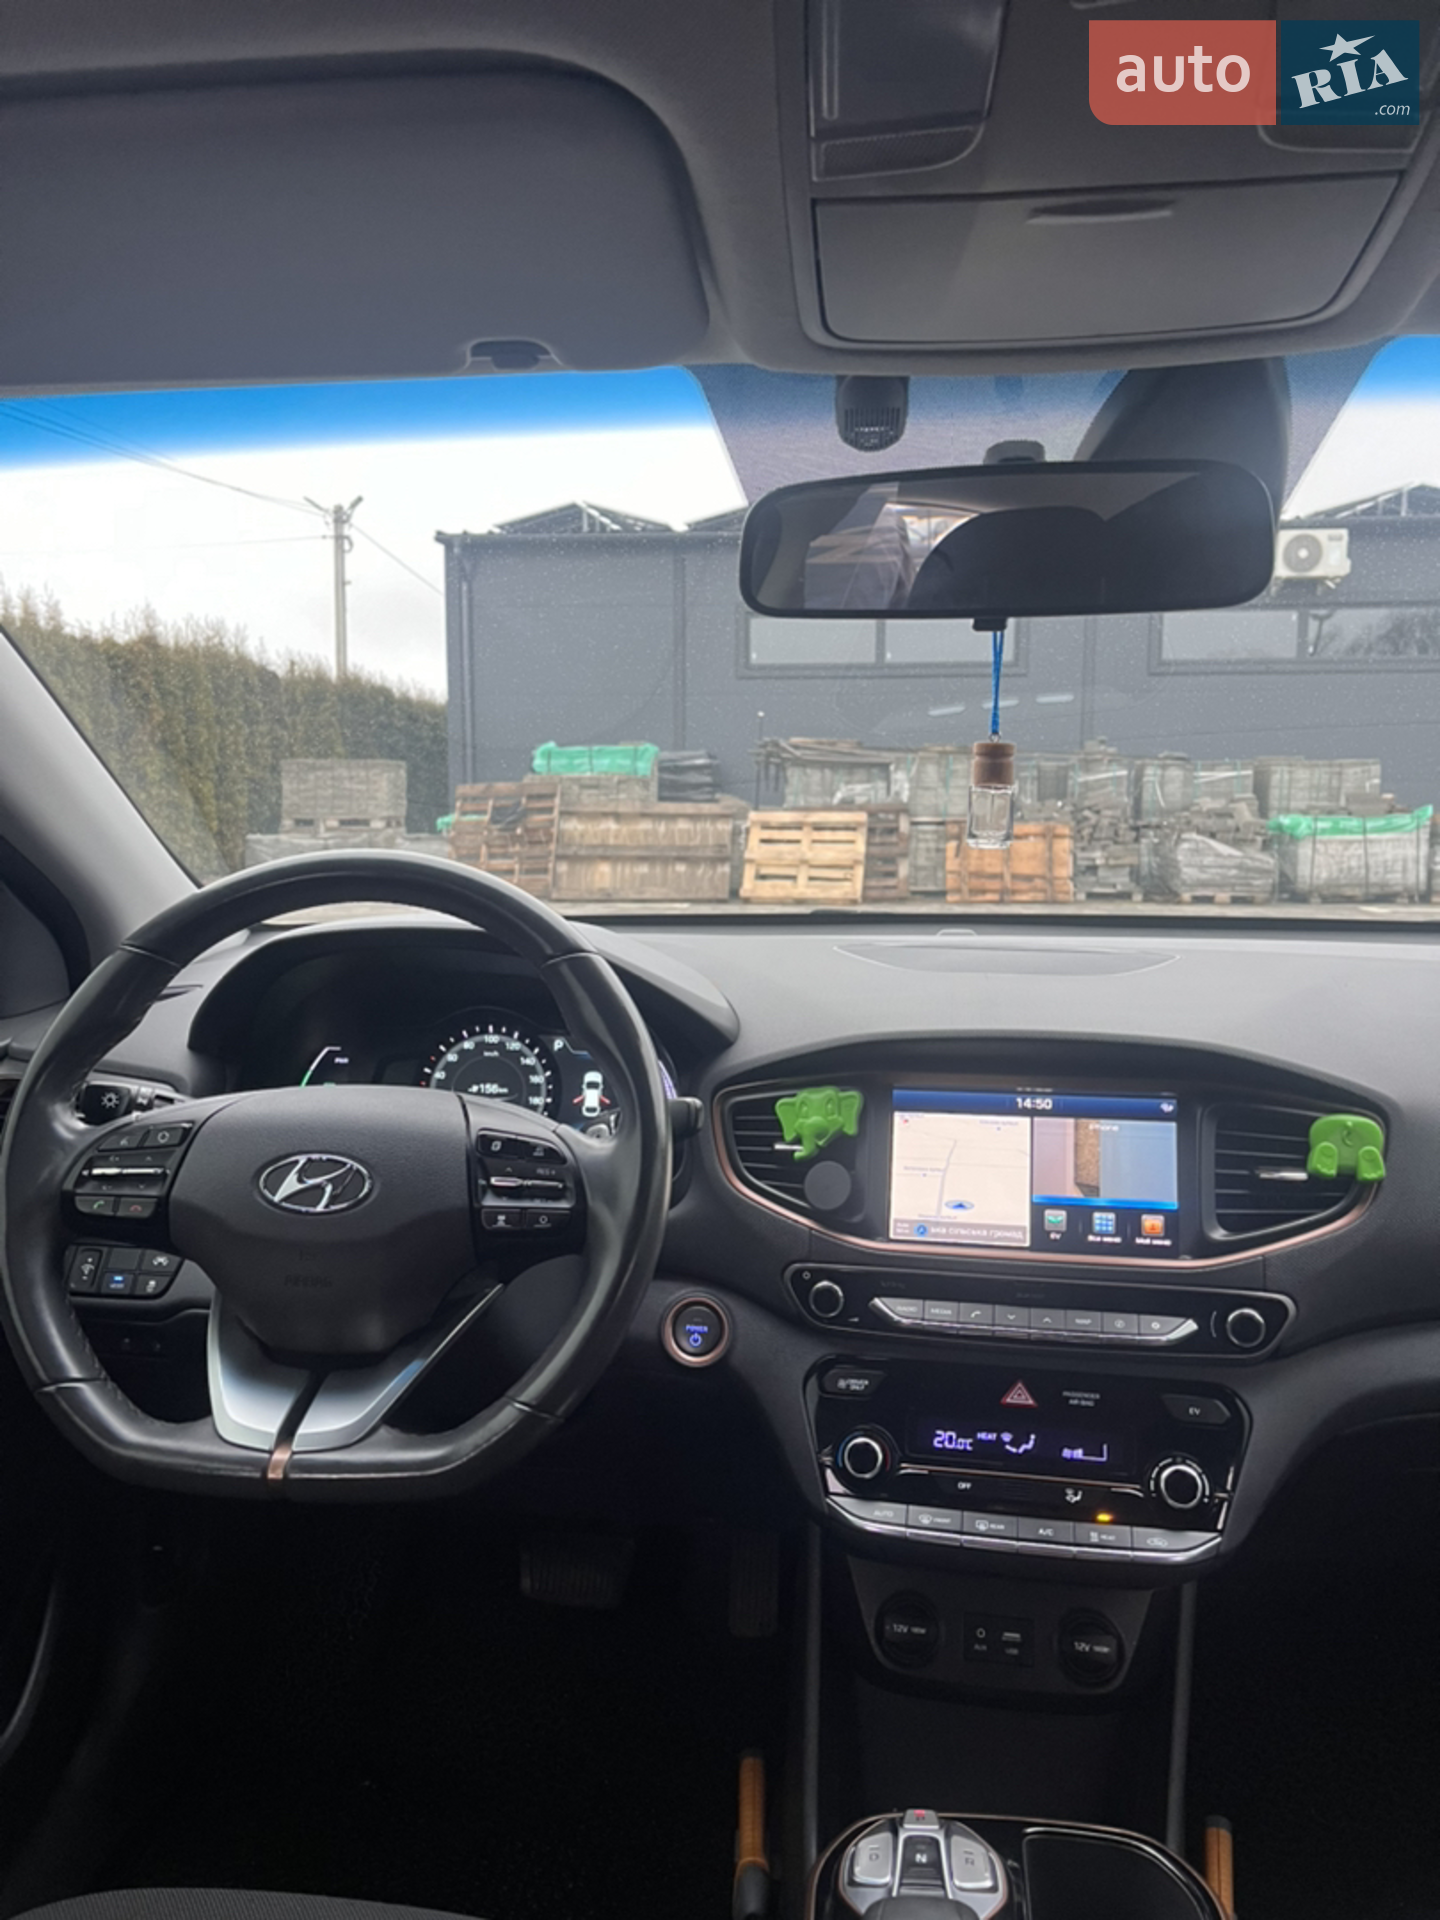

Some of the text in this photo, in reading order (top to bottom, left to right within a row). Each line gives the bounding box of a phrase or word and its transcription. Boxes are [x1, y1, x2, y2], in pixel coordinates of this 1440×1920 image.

[483, 1034, 500, 1044] 100
[553, 1039, 564, 1051] P
[1015, 1097, 1053, 1110] 14:50
[1188, 1406, 1201, 1416] EV
[977, 1431, 998, 1441] HEAT
[957, 1481, 972, 1490] OFF
[1037, 1527, 1054, 1537] A/C
[892, 1622, 909, 1633] 12V
[1073, 1640, 1090, 1652] 12V
[915, 1852, 927, 1863] N
